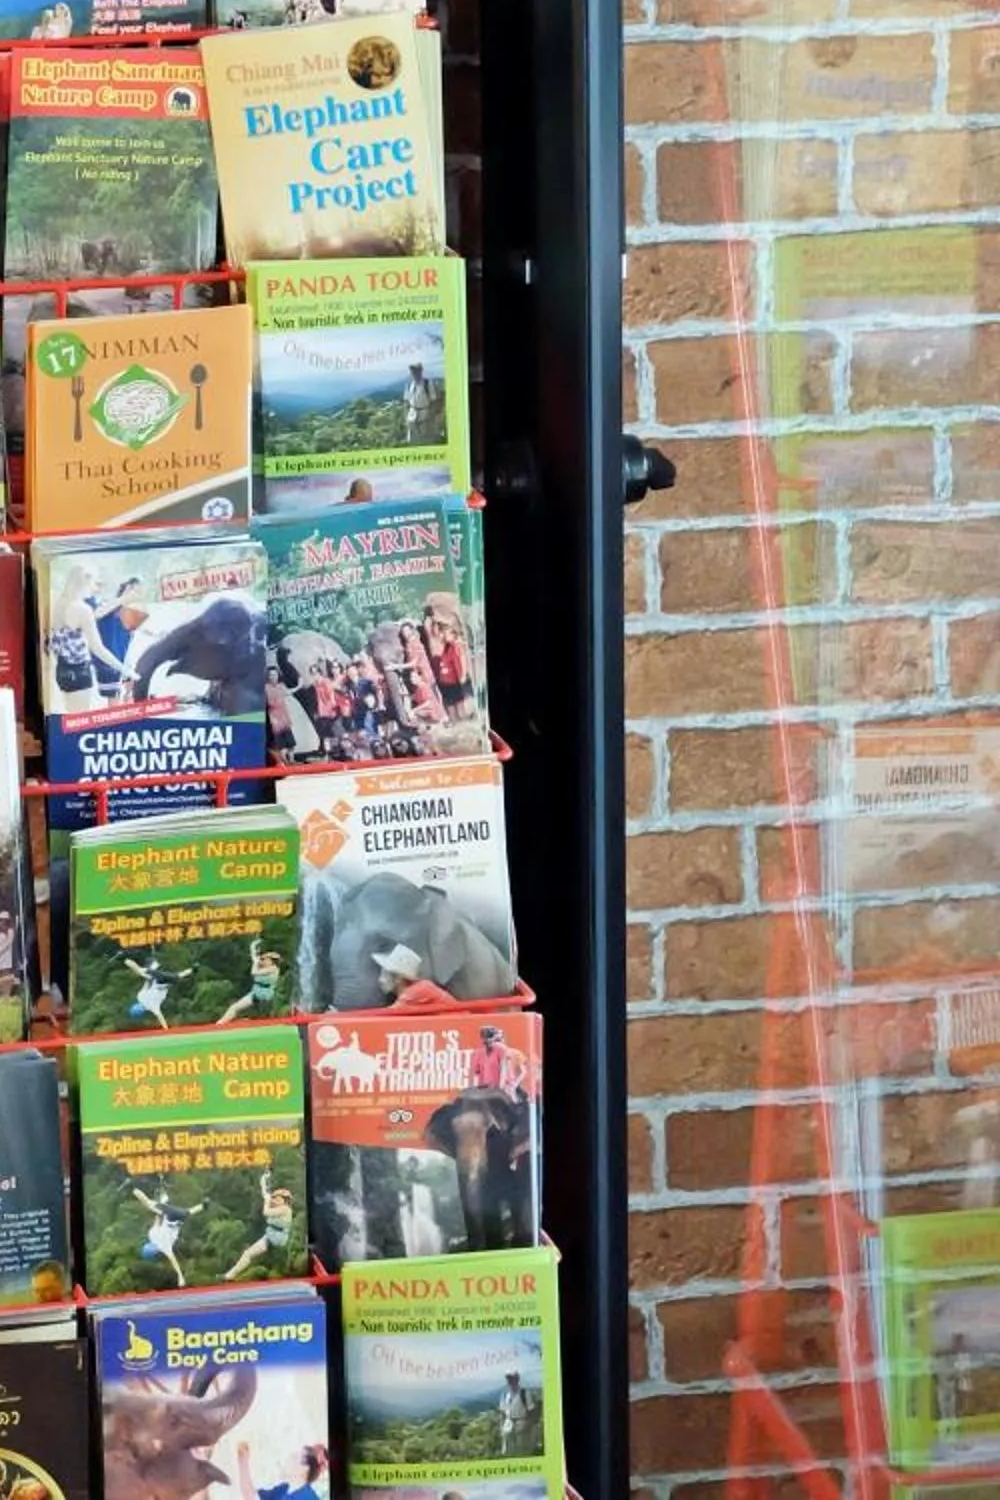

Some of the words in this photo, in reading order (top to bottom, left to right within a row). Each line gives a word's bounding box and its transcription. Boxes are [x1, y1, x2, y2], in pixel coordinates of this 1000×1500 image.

[23, 59, 109, 84] Elephant
[225, 61, 297, 84] Chiang
[301, 53, 340, 74] Mai
[23, 86, 92, 107] Nature
[96, 86, 156, 111] Camp
[244, 87, 407, 138] Elephant
[310, 135, 414, 176] Care
[289, 168, 417, 214] Project
[266, 275, 356, 298] PANDA
[366, 268, 438, 292] TOUR
[47, 346, 76, 372] 17
[81, 334, 199, 360] NIMMAN
[59, 460, 113, 481] Thai
[121, 450, 222, 474] Cooking
[275, 456, 337, 473] Elephant
[374, 453, 446, 468] experience
[102, 473, 179, 497] School
[305, 522, 440, 567] MAYRIN
[79, 725, 233, 753] CHIANGMAI
[83, 747, 227, 775] MOUNTAIN
[361, 797, 453, 827] CHIANGMAI
[363, 820, 491, 853] ELEPHANTLAND
[97, 845, 200, 871] Elephant
[206, 839, 287, 858] Nature
[220, 860, 286, 880] Camp
[91, 915, 146, 936] Zipline
[150, 911, 164, 927] &
[168, 904, 241, 925] Elephant
[245, 900, 295, 918] riding
[98, 1056, 201, 1083] Elephant
[208, 1051, 289, 1073] Nature
[376, 1049, 474, 1076] ELEPHANT
[223, 1078, 290, 1100] Camp
[97, 1135, 153, 1157] Zipline
[156, 1132, 170, 1151] &
[174, 1129, 249, 1150] Elephant
[252, 1126, 300, 1145] riding
[353, 1278, 449, 1301] PANDA
[460, 1273, 537, 1297] TOUR
[166, 1319, 313, 1349] Baanchang
[387, 1318, 432, 1333] touristic
[437, 1318, 458, 1330] trek
[462, 1318, 472, 1329] in
[477, 1317, 515, 1329] remote
[519, 1315, 542, 1327] area
[166, 1351, 207, 1369] Day
[212, 1347, 259, 1364] Care
[362, 1466, 428, 1481] Elephant
[468, 1463, 542, 1478] experience
